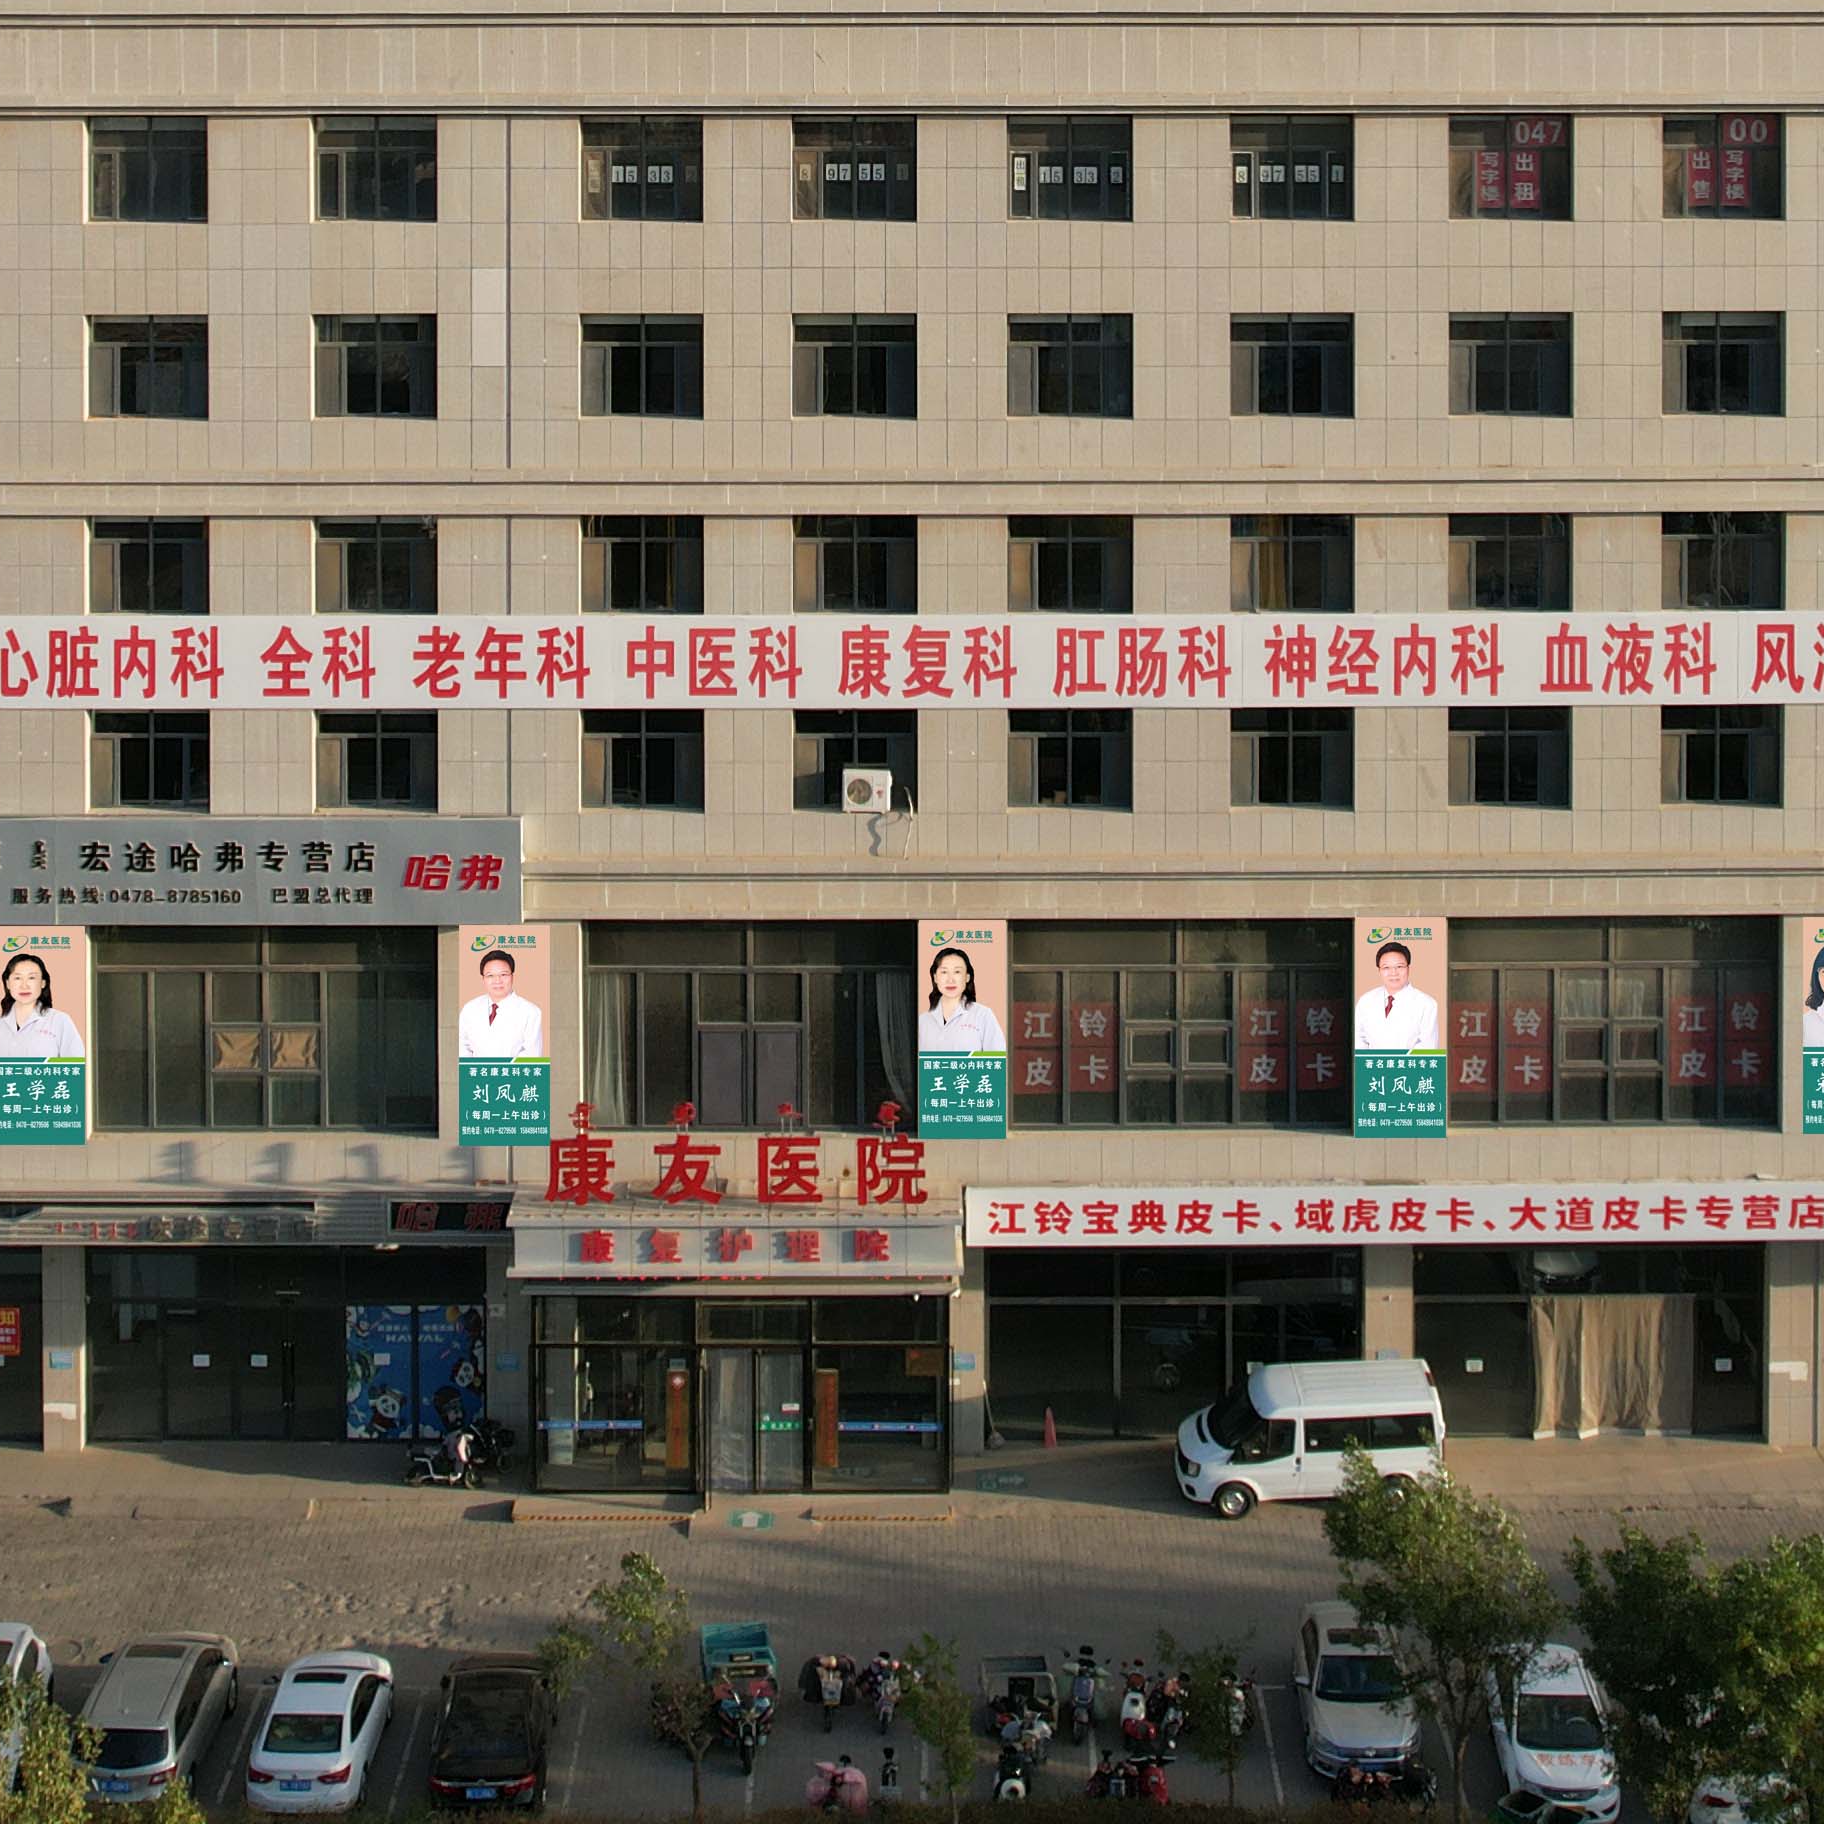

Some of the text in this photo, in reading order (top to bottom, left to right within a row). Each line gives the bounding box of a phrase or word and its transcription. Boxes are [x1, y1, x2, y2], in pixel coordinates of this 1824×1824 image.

[1514, 121, 1562, 144] 047
[1514, 153, 1535, 202] 出租
[1691, 151, 1711, 200] 出售
[260, 625, 377, 699] 全科
[412, 625, 591, 700] 老年科
[626, 624, 803, 700] 中医科
[838, 623, 1018, 699] 康复科
[1052, 624, 1232, 698] 肛肠科
[1264, 623, 1505, 698] 神经内科
[1539, 622, 1717, 695] 血液科
[79, 840, 377, 874] 宏途哈弗专营店
[403, 853, 504, 892] 哈弗
[271, 887, 375, 906] 巴盟总代理
[1023, 1008, 1108, 1042] 江铃
[1248, 1007, 1337, 1040] 江铃
[1457, 1007, 1544, 1043] 江铃
[1676, 1001, 1760, 1034] 江铃
[469, 1067, 542, 1077] 著名康复科专家
[923, 1060, 1002, 1070] 国家二级心内科专家
[1023, 1054, 1108, 1088] 皮卡
[1248, 1052, 1337, 1086] 皮卡
[1365, 1059, 1438, 1069] 著名康复科专家
[1457, 1054, 1544, 1093] 皮卡
[1676, 1047, 1760, 1082] 皮卡
[1, 1079, 71, 1101] 王学磊
[472, 1083, 540, 1104] 刘凤麒
[929, 1073, 993, 1095] 王学磊
[1368, 1075, 1436, 1096] 刘凤麒
[546, 1132, 928, 1206] 康友医院
[579, 1228, 891, 1264] 康复护理院
[384, 1334, 445, 1343] HAVAL
